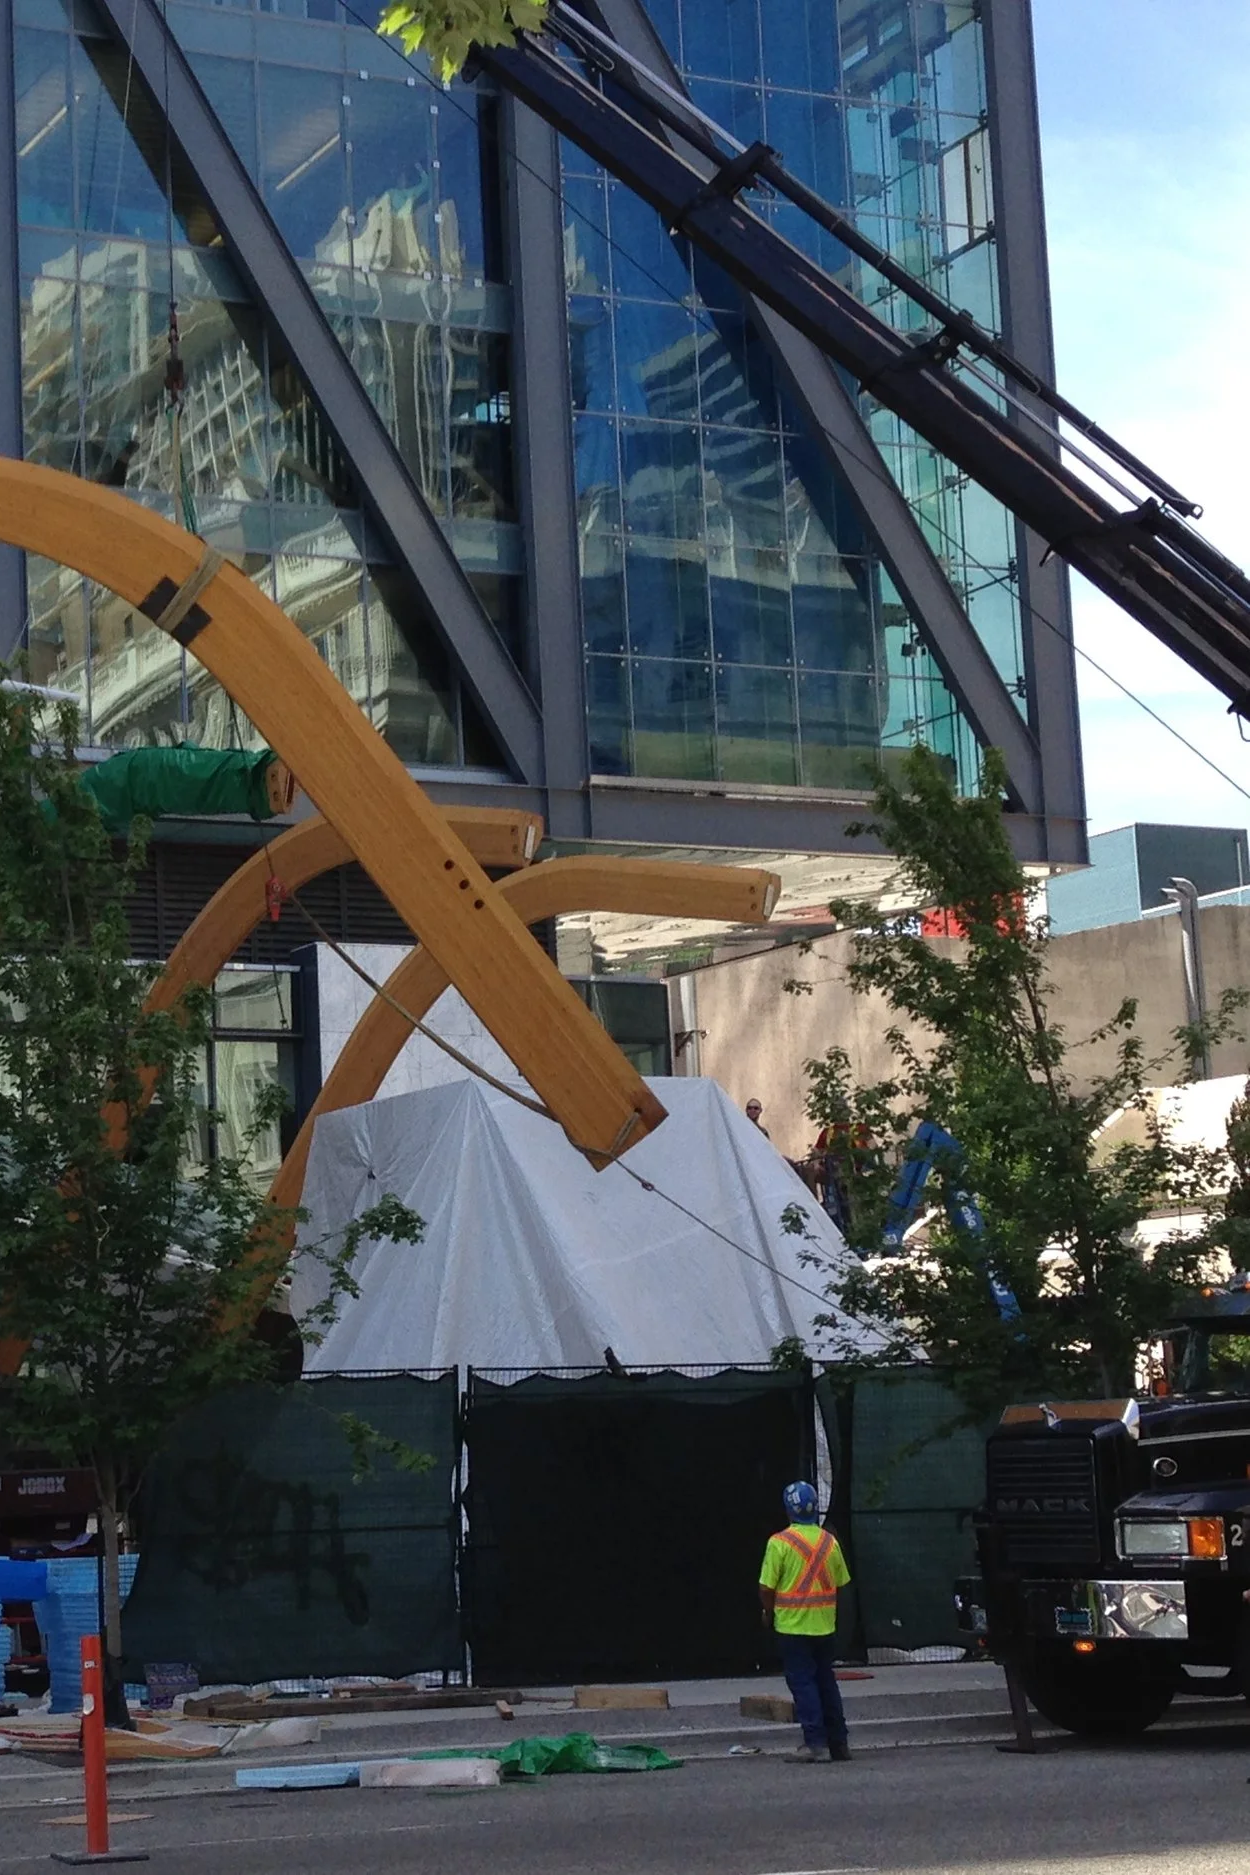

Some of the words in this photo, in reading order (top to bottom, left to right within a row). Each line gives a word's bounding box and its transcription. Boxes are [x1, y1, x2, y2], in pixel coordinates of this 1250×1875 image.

[18, 1476, 66, 1495] JOBOX
[996, 1498, 1091, 1513] MACK
[1230, 1524, 1243, 1546] 2
